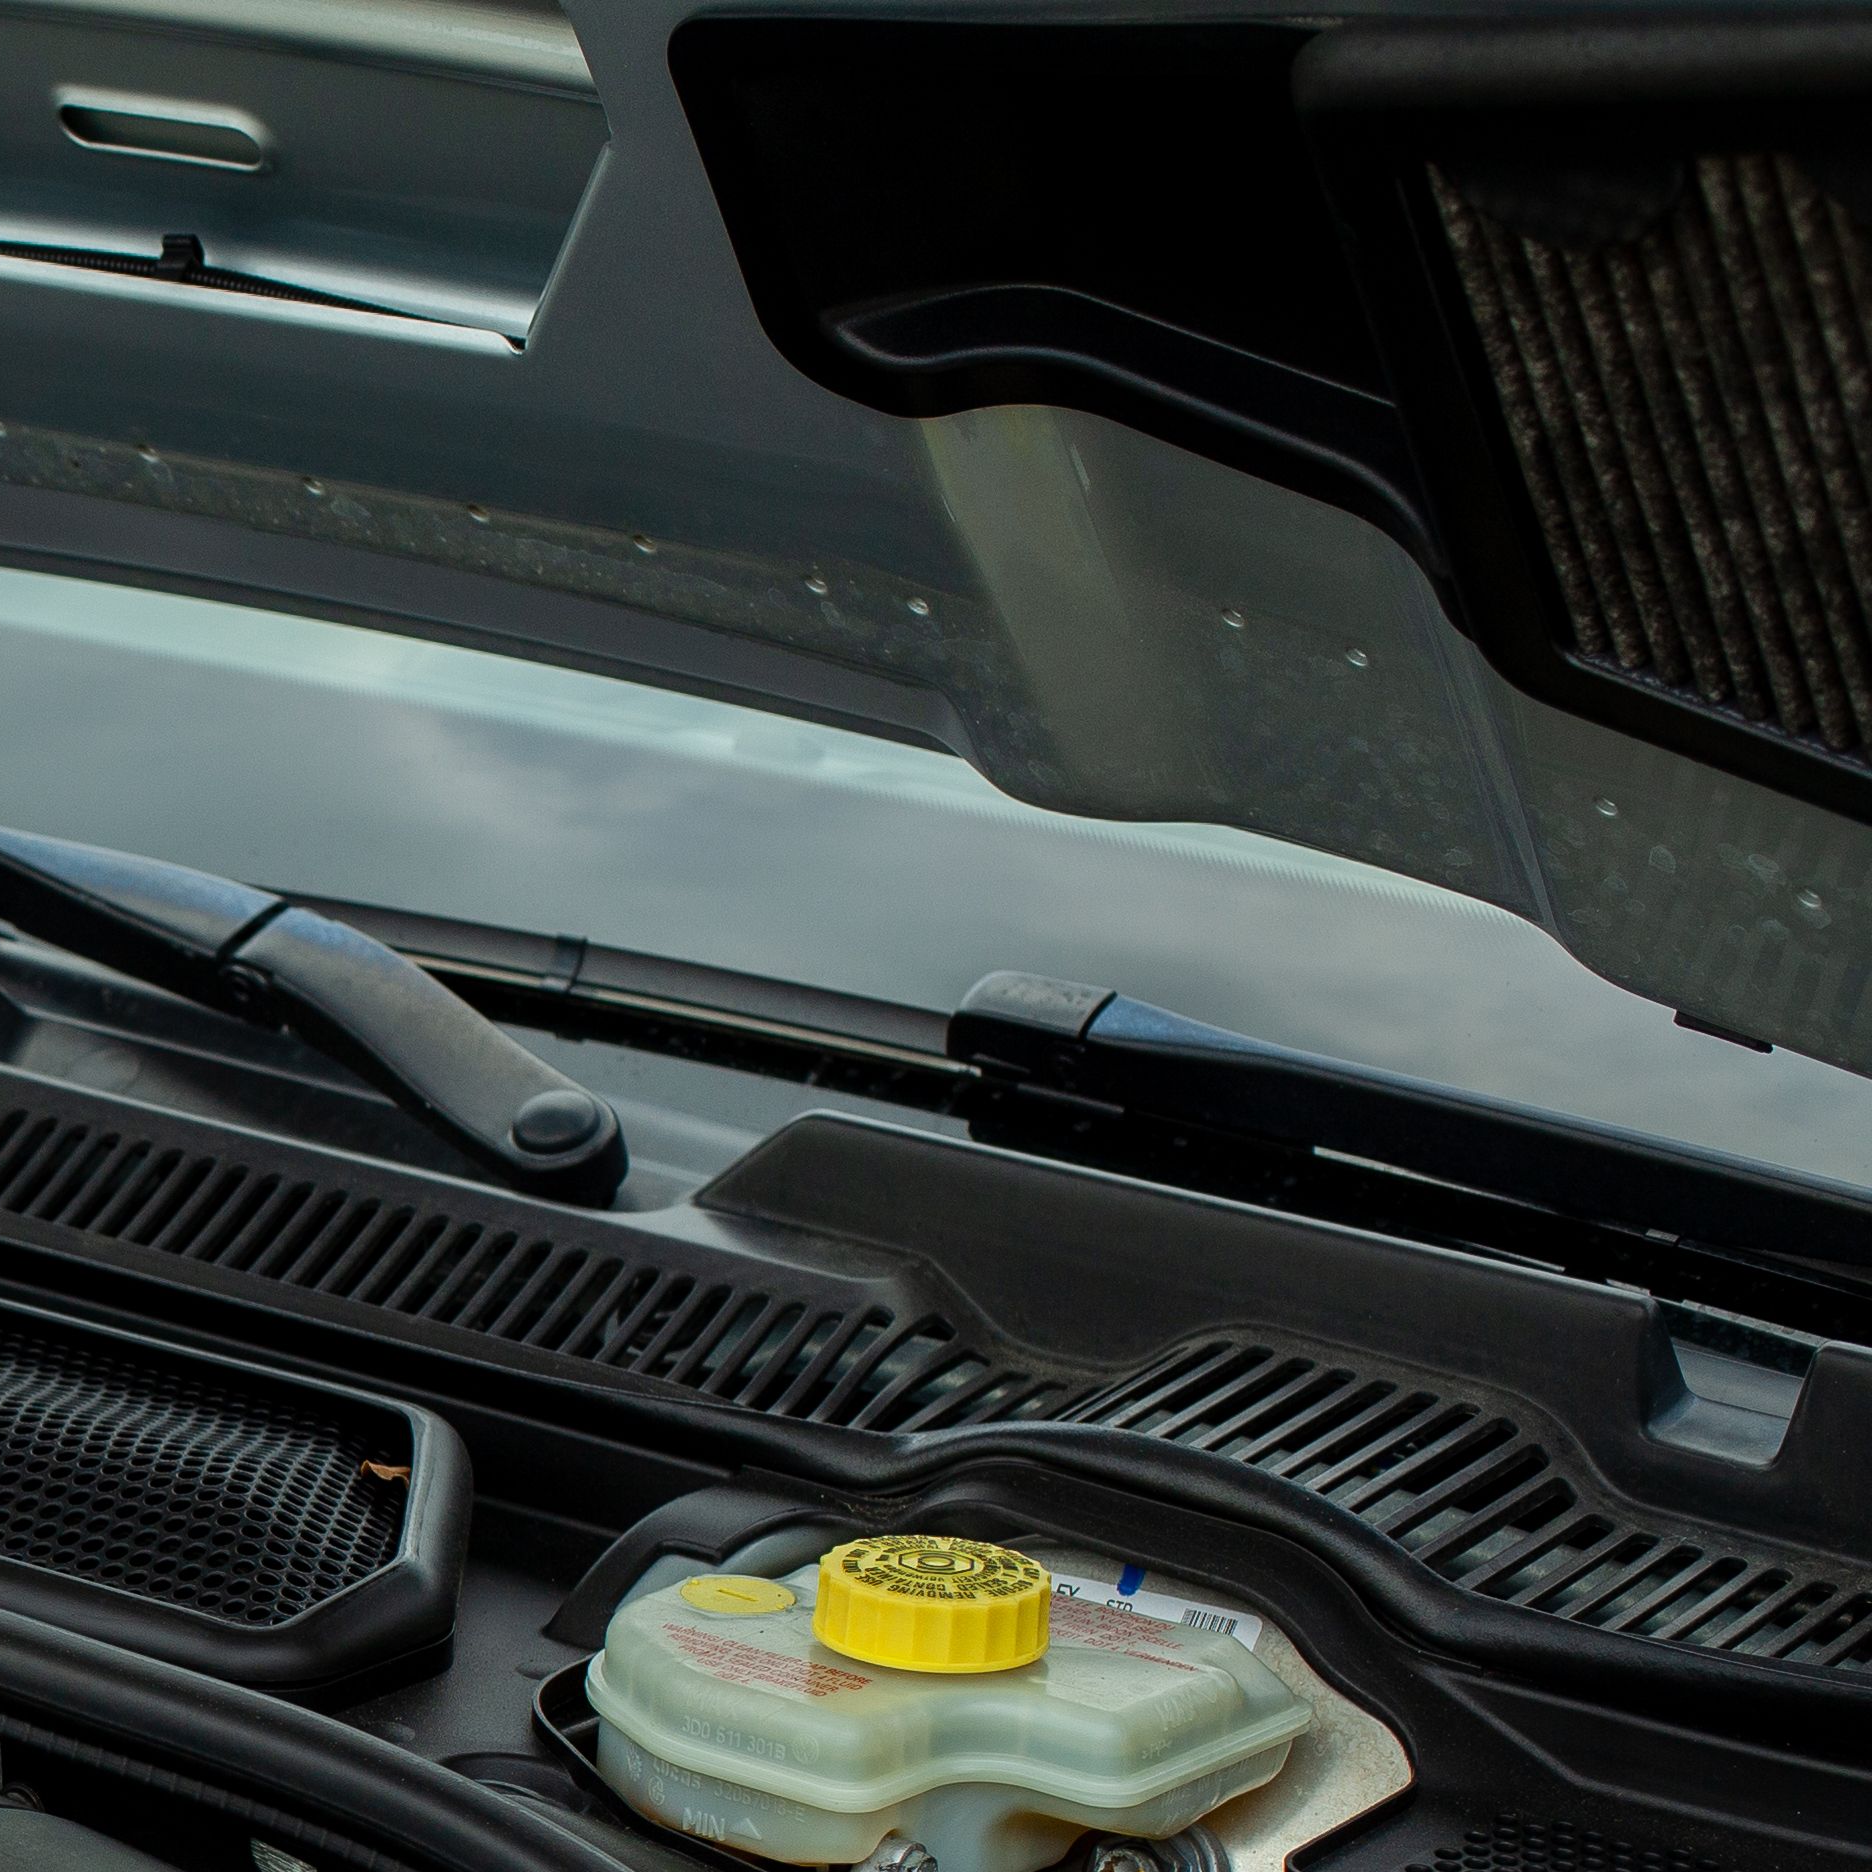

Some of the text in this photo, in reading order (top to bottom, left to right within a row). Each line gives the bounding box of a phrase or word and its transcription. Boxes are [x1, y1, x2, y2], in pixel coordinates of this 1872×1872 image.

[855, 1574, 885, 1587] USE
[886, 1583, 976, 1600] REMOVING
[678, 1644, 715, 1658] FROM
[721, 1639, 763, 1654] CLEAN
[801, 1661, 825, 1671] CAP
[823, 1667, 872, 1685] BEFORE
[713, 1670, 740, 1681] DOT
[790, 1666, 818, 1677] DOT
[826, 1677, 862, 1690] FLUID
[681, 1806, 726, 1841] MIN
